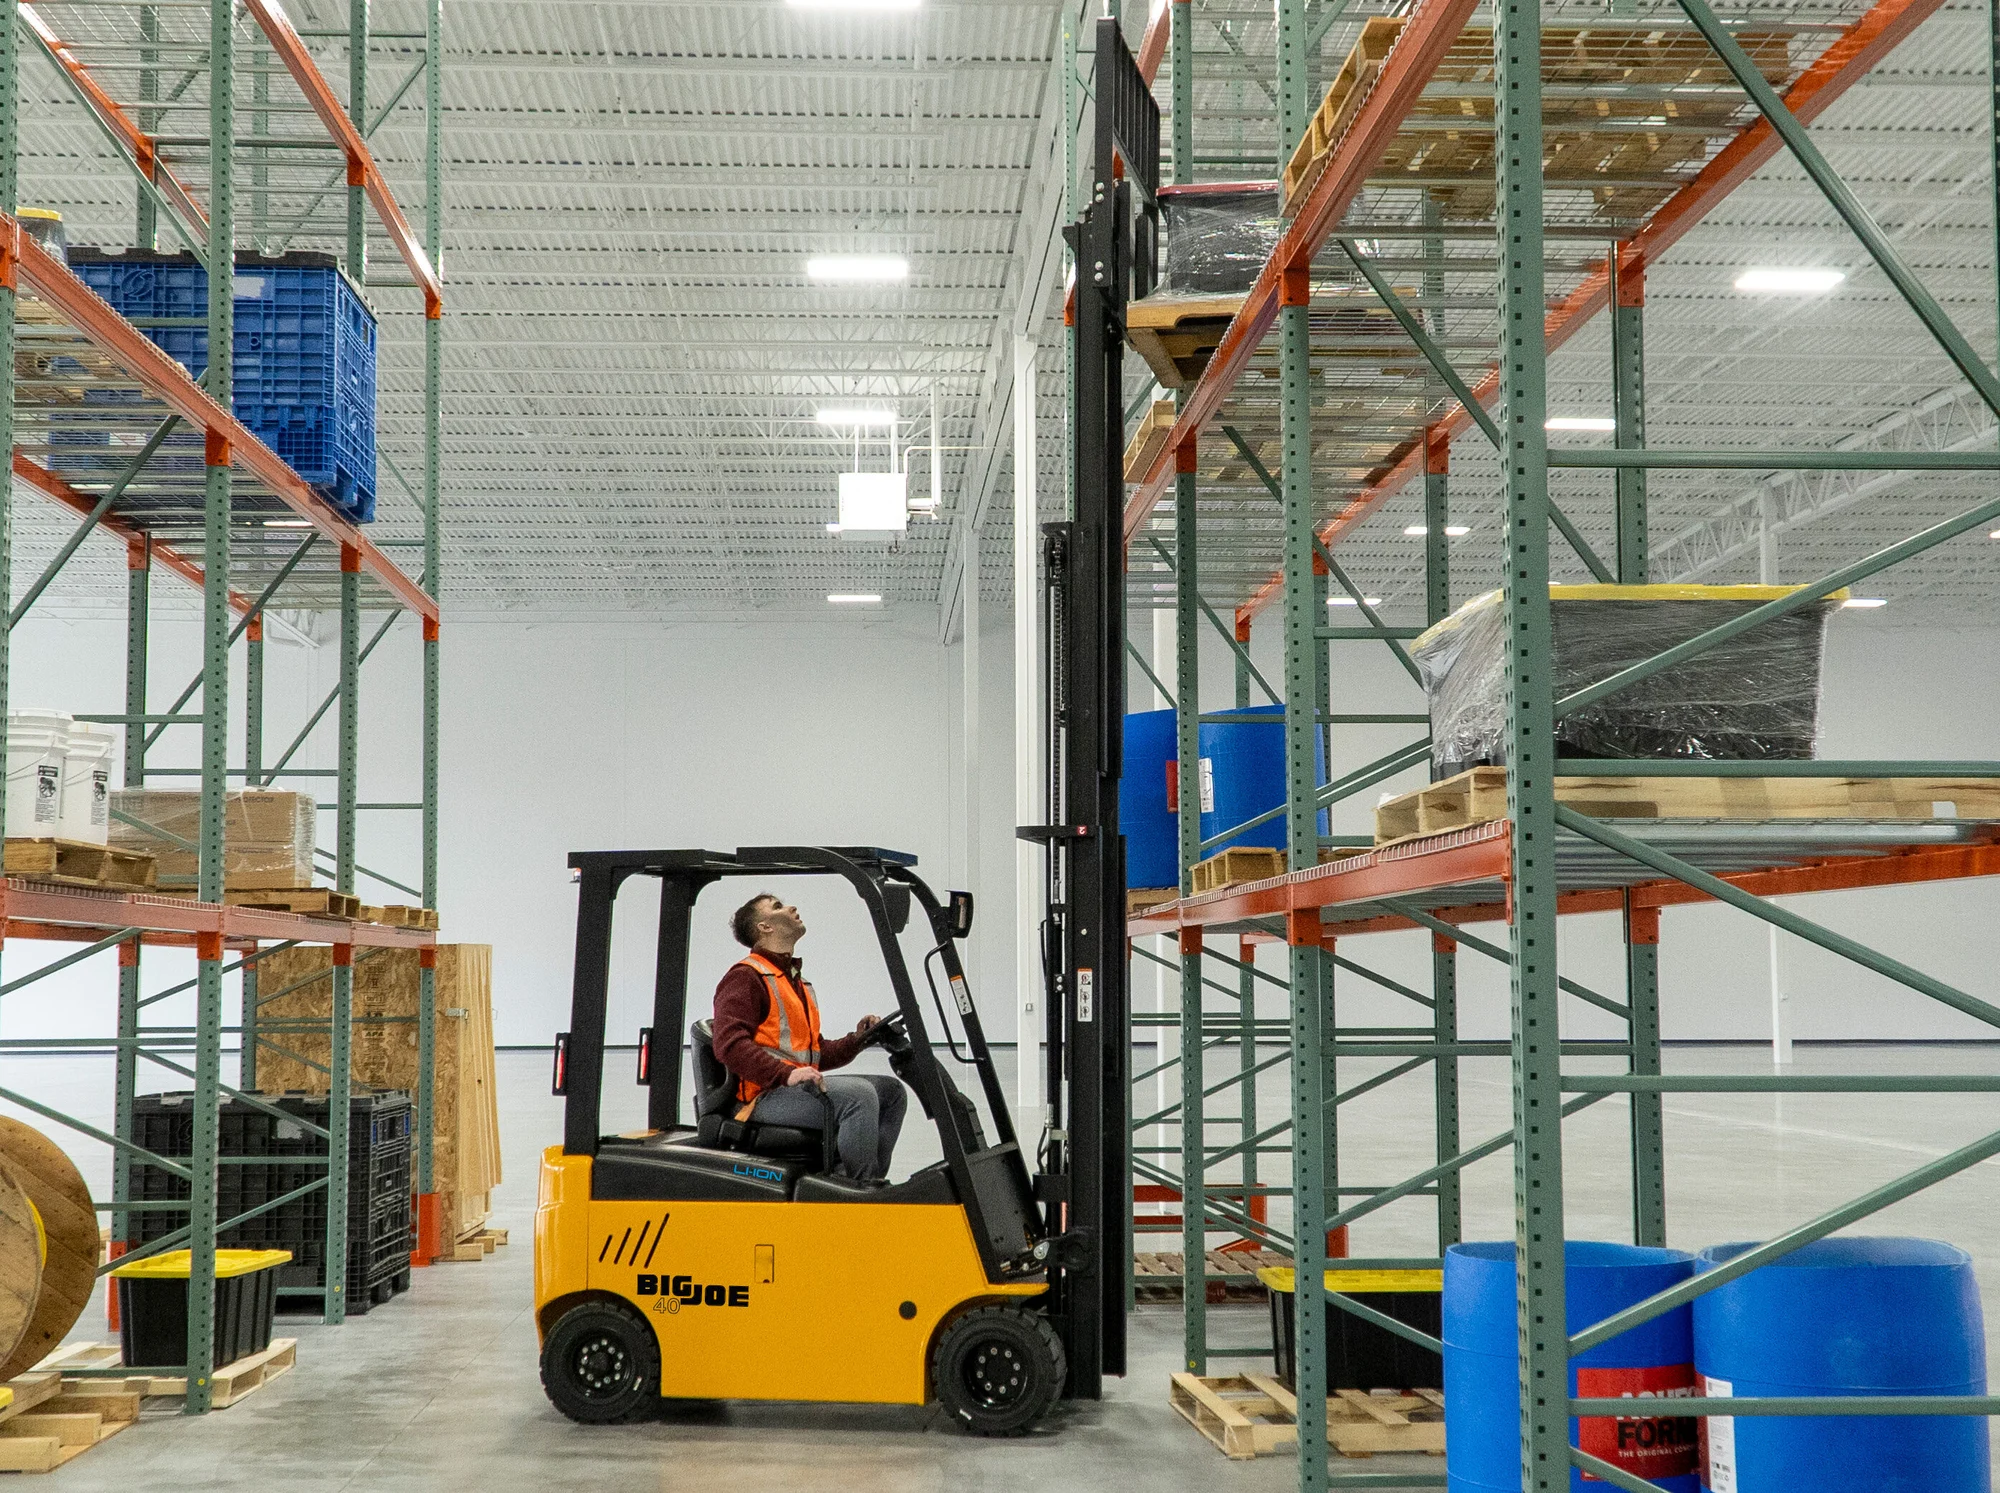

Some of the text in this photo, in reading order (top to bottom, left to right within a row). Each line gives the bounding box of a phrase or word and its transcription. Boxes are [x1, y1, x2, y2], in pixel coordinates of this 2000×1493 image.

[653, 1297, 681, 1314] 40
[1618, 1450, 1634, 1458] THE
[1636, 1446, 1673, 1457] ORIGINAL
